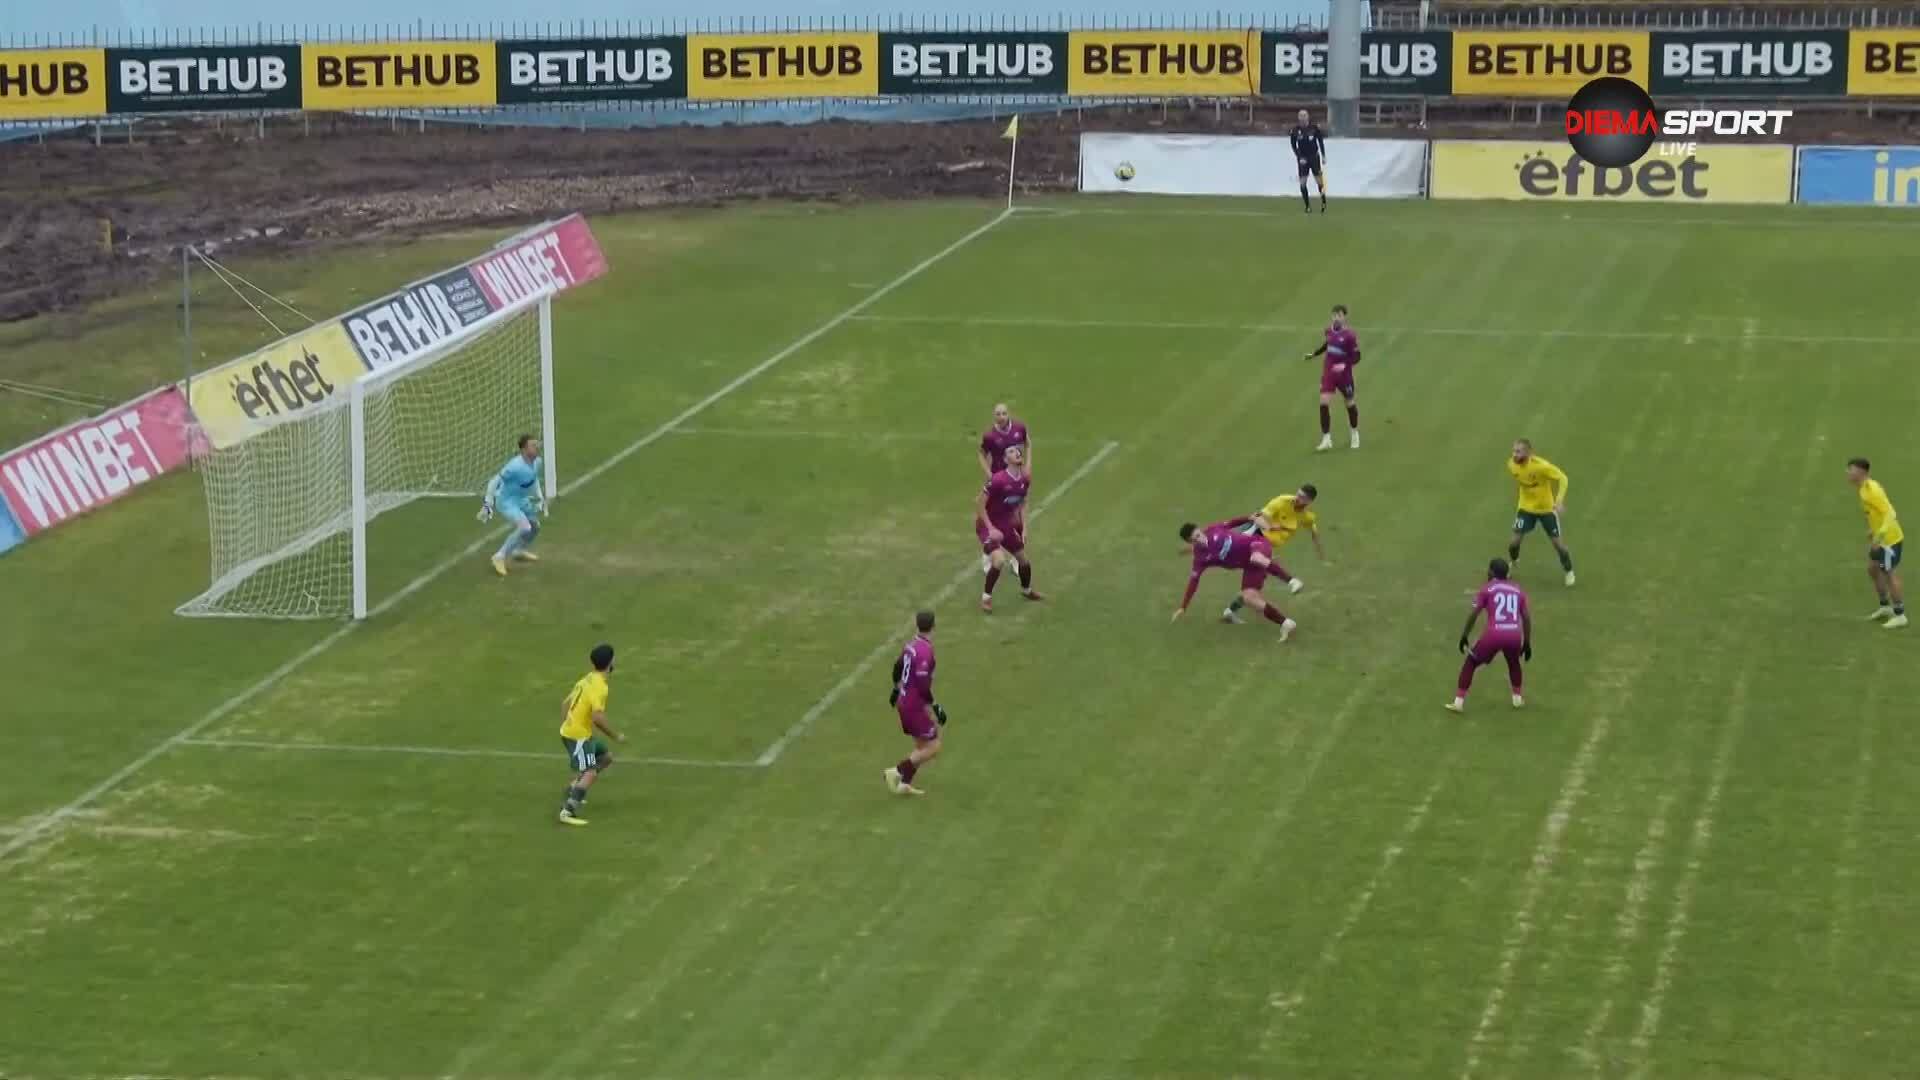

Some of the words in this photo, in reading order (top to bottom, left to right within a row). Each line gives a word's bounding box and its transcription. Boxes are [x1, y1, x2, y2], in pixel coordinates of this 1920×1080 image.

[120, 56, 287, 93] BETHUB
[317, 54, 480, 88] BETHUB
[510, 48, 673, 86] BETHUB
[703, 44, 862, 79] BETHUB
[892, 43, 1054, 76] BETHUB
[1083, 43, 1245, 75] BETHUB
[1275, 43, 1438, 75] BEHUB
[1468, 43, 1632, 75] BETHUB
[1663, 41, 1833, 77] BETHUB
[1518, 151, 1709, 198] efbet
[479, 232, 575, 303] WINBET
[348, 283, 464, 363] BETHUB
[234, 344, 334, 419] efbet
[3, 410, 164, 528] WINBET
[1494, 591, 1518, 621] 24
